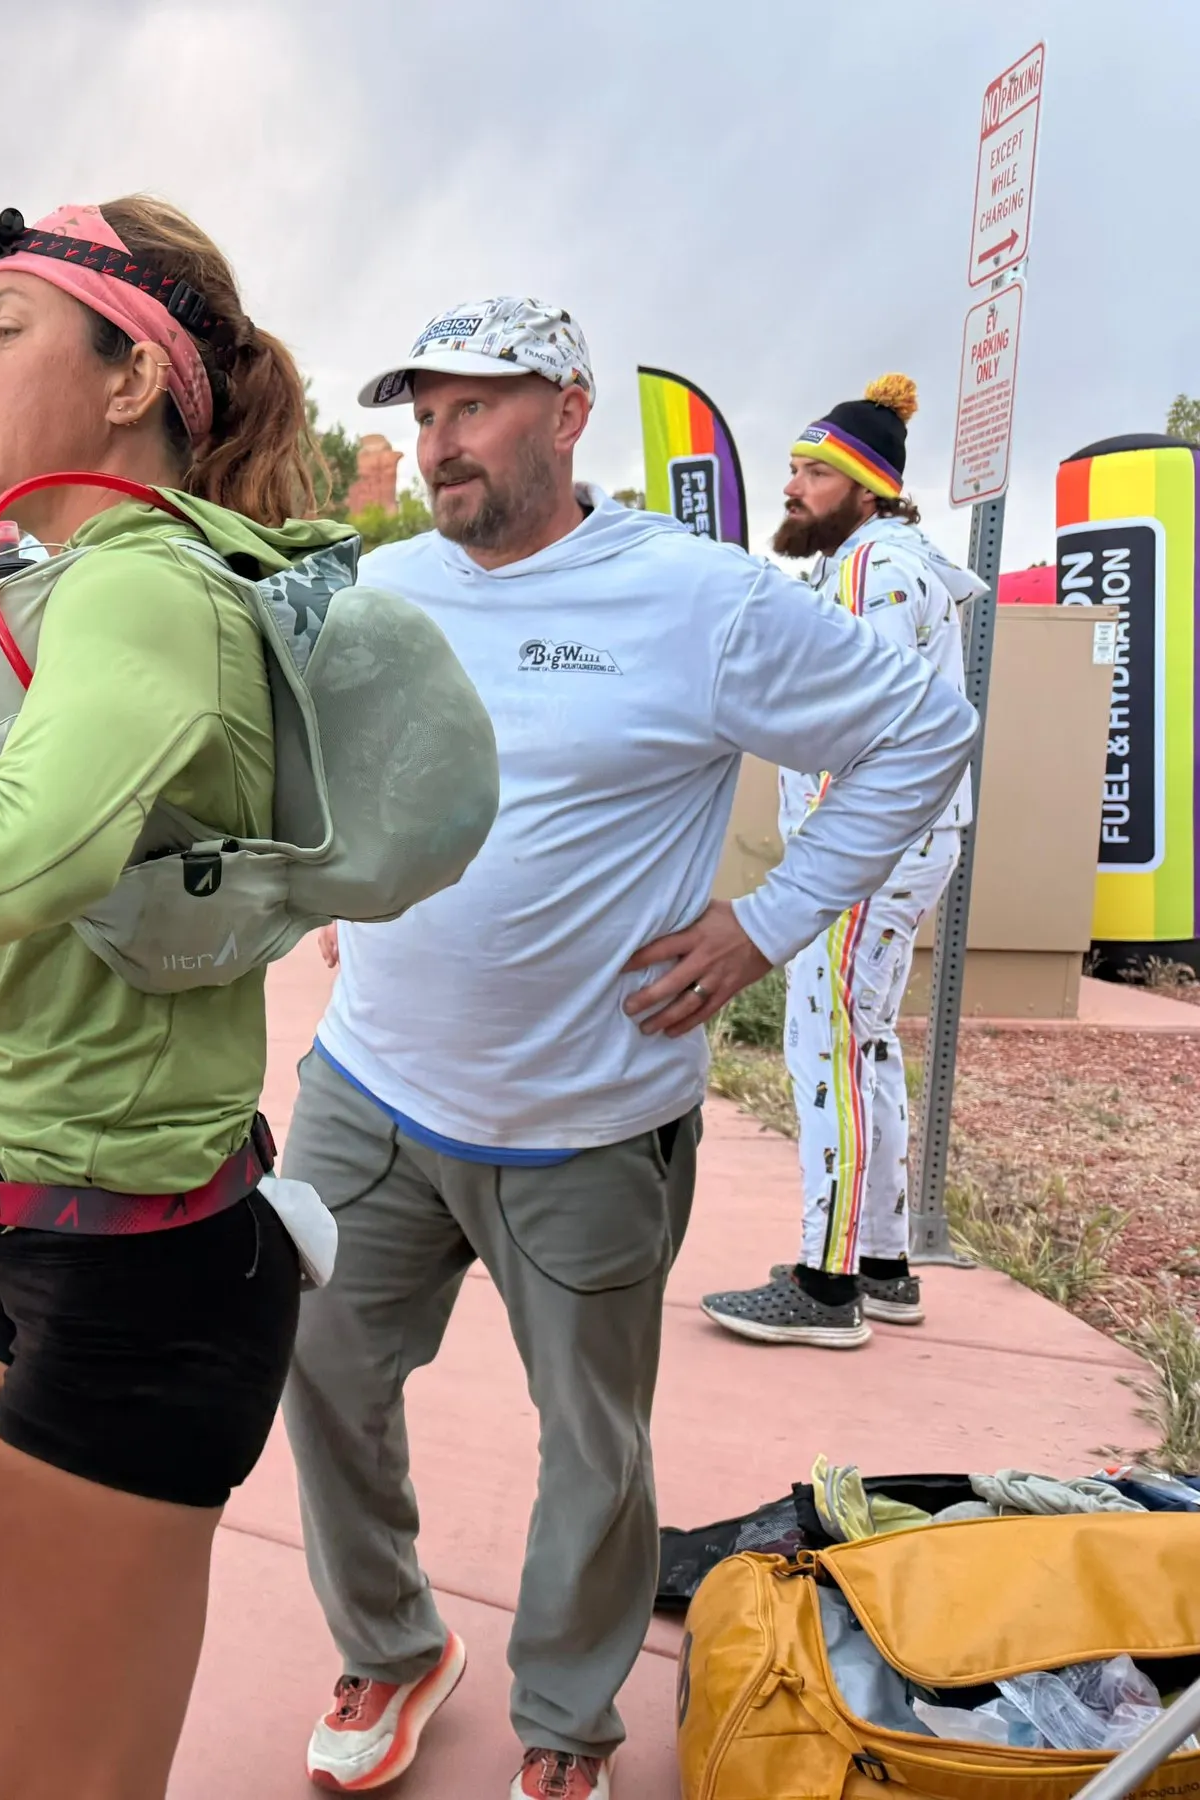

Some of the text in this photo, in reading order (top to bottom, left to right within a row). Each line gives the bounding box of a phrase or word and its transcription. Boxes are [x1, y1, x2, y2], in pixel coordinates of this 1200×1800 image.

[983, 60, 1040, 133] NO PARKING
[990, 129, 1024, 170] EXCEPT
[991, 163, 1018, 197] WHILE
[979, 188, 1024, 232] CHARGING
[986, 310, 998, 334] EV
[971, 328, 1009, 365] PARKING
[977, 356, 1000, 385] ONLY
[681, 472, 694, 520] FUEL
[1106, 735, 1130, 756] &
[1102, 763, 1131, 844] FUEL
